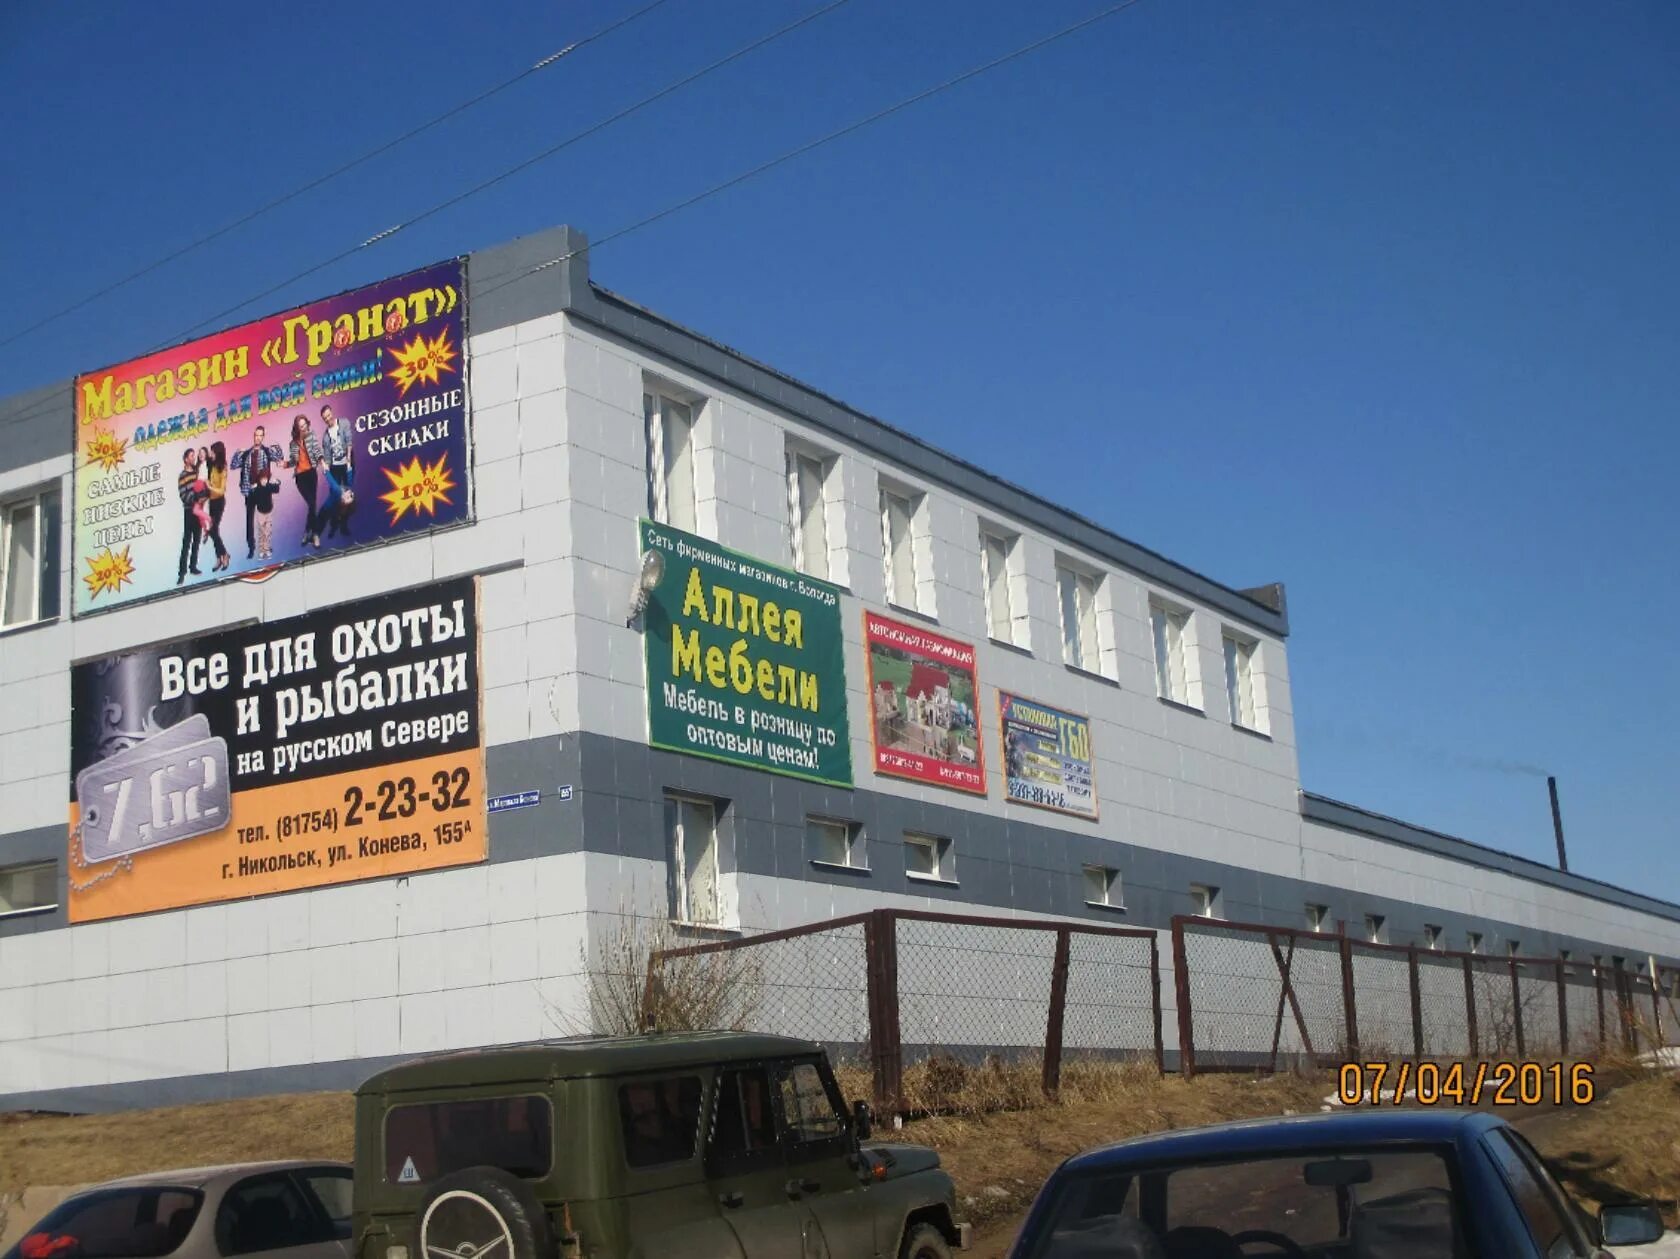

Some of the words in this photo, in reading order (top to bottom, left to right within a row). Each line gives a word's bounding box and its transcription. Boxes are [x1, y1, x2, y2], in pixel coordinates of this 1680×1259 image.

[81, 345, 249, 425] Магазин
[261, 285, 457, 365] «Гранат»
[405, 348, 444, 378] 30%
[355, 389, 462, 432] СЕЗОННЫЕ
[368, 420, 449, 456] СКИДКИ
[88, 463, 160, 499] САМЫЕ
[401, 476, 438, 500] 10%
[83, 488, 165, 526] НИЗКИЕ
[94, 516, 153, 549] ЦЕНЫ
[648, 528, 674, 551] Сеть
[676, 539, 736, 571] фирменных
[97, 565, 122, 582] 20%
[682, 567, 803, 649] Аллея
[159, 654, 229, 701] Все
[243, 632, 317, 689] для
[332, 599, 466, 663] охоты
[671, 624, 818, 713] Мебели
[236, 696, 260, 735] и
[276, 652, 468, 738] рыбалки
[663, 681, 728, 722] Мебель
[735, 706, 745, 725] в
[751, 709, 812, 745] розницу
[817, 727, 836, 747] по
[237, 750, 264, 775] на
[273, 729, 372, 774] русском
[381, 710, 469, 748] Севере
[687, 723, 763, 758] оптовым
[767, 746, 820, 770] ценам!
[237, 825, 269, 844] тел.
[277, 808, 338, 842] (81754)
[344, 767, 471, 827] 2-23-32
[222, 864, 233, 879] г.
[238, 849, 322, 877] Никольск,
[328, 845, 352, 867] ул.
[359, 833, 427, 858] Конева,
